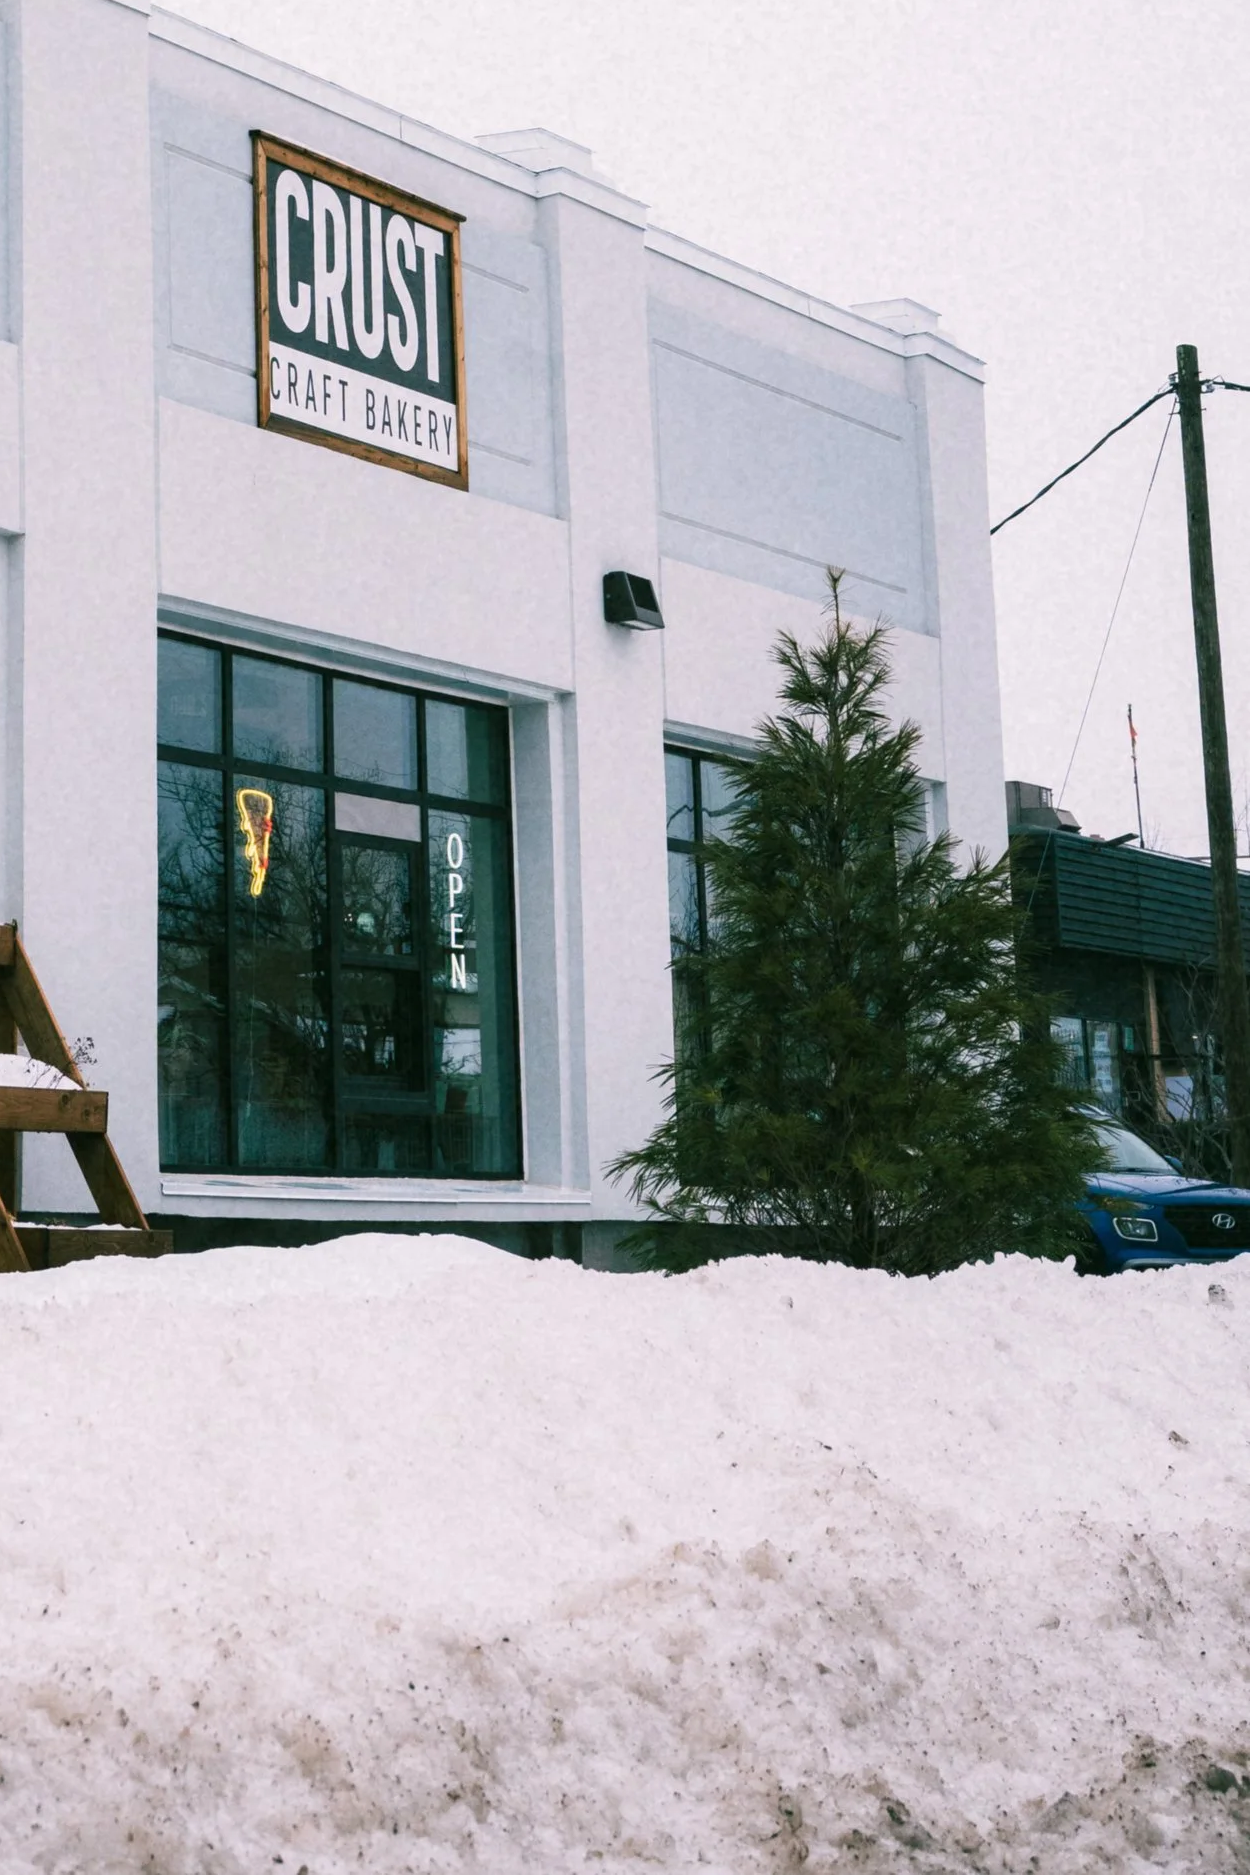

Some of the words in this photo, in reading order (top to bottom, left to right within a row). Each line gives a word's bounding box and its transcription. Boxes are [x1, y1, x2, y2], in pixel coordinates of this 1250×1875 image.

[275, 169, 444, 383] CRUST
[270, 356, 349, 422] CRAFT
[365, 389, 453, 456] BAKERY
[447, 833, 467, 990] OPEN
